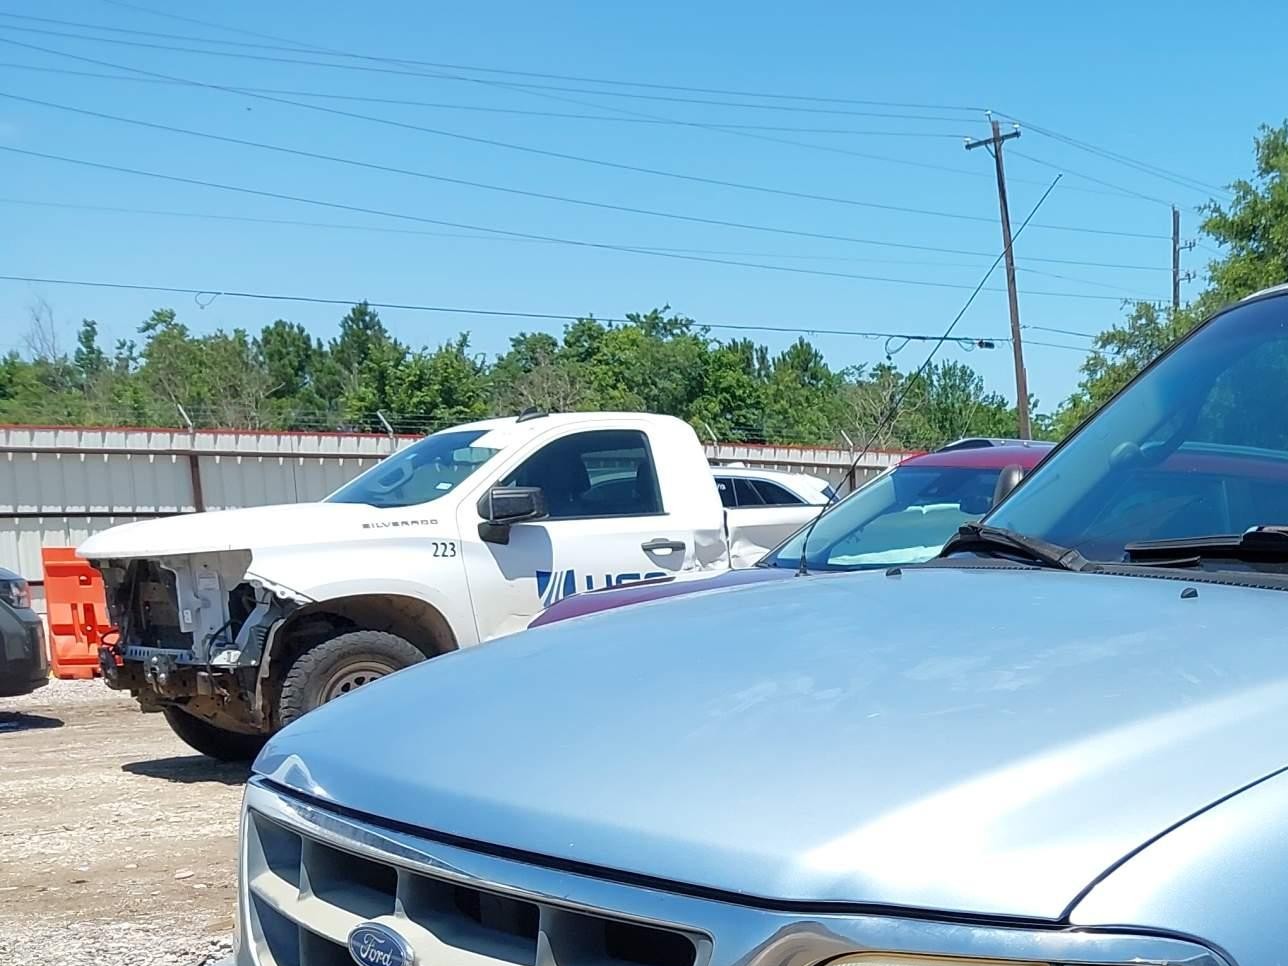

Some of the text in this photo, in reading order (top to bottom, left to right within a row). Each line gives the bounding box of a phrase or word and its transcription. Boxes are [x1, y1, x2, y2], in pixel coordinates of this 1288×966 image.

[361, 518, 439, 530] SILVERADO
[431, 542, 457, 558] 223
[359, 932, 394, 966] Ford
